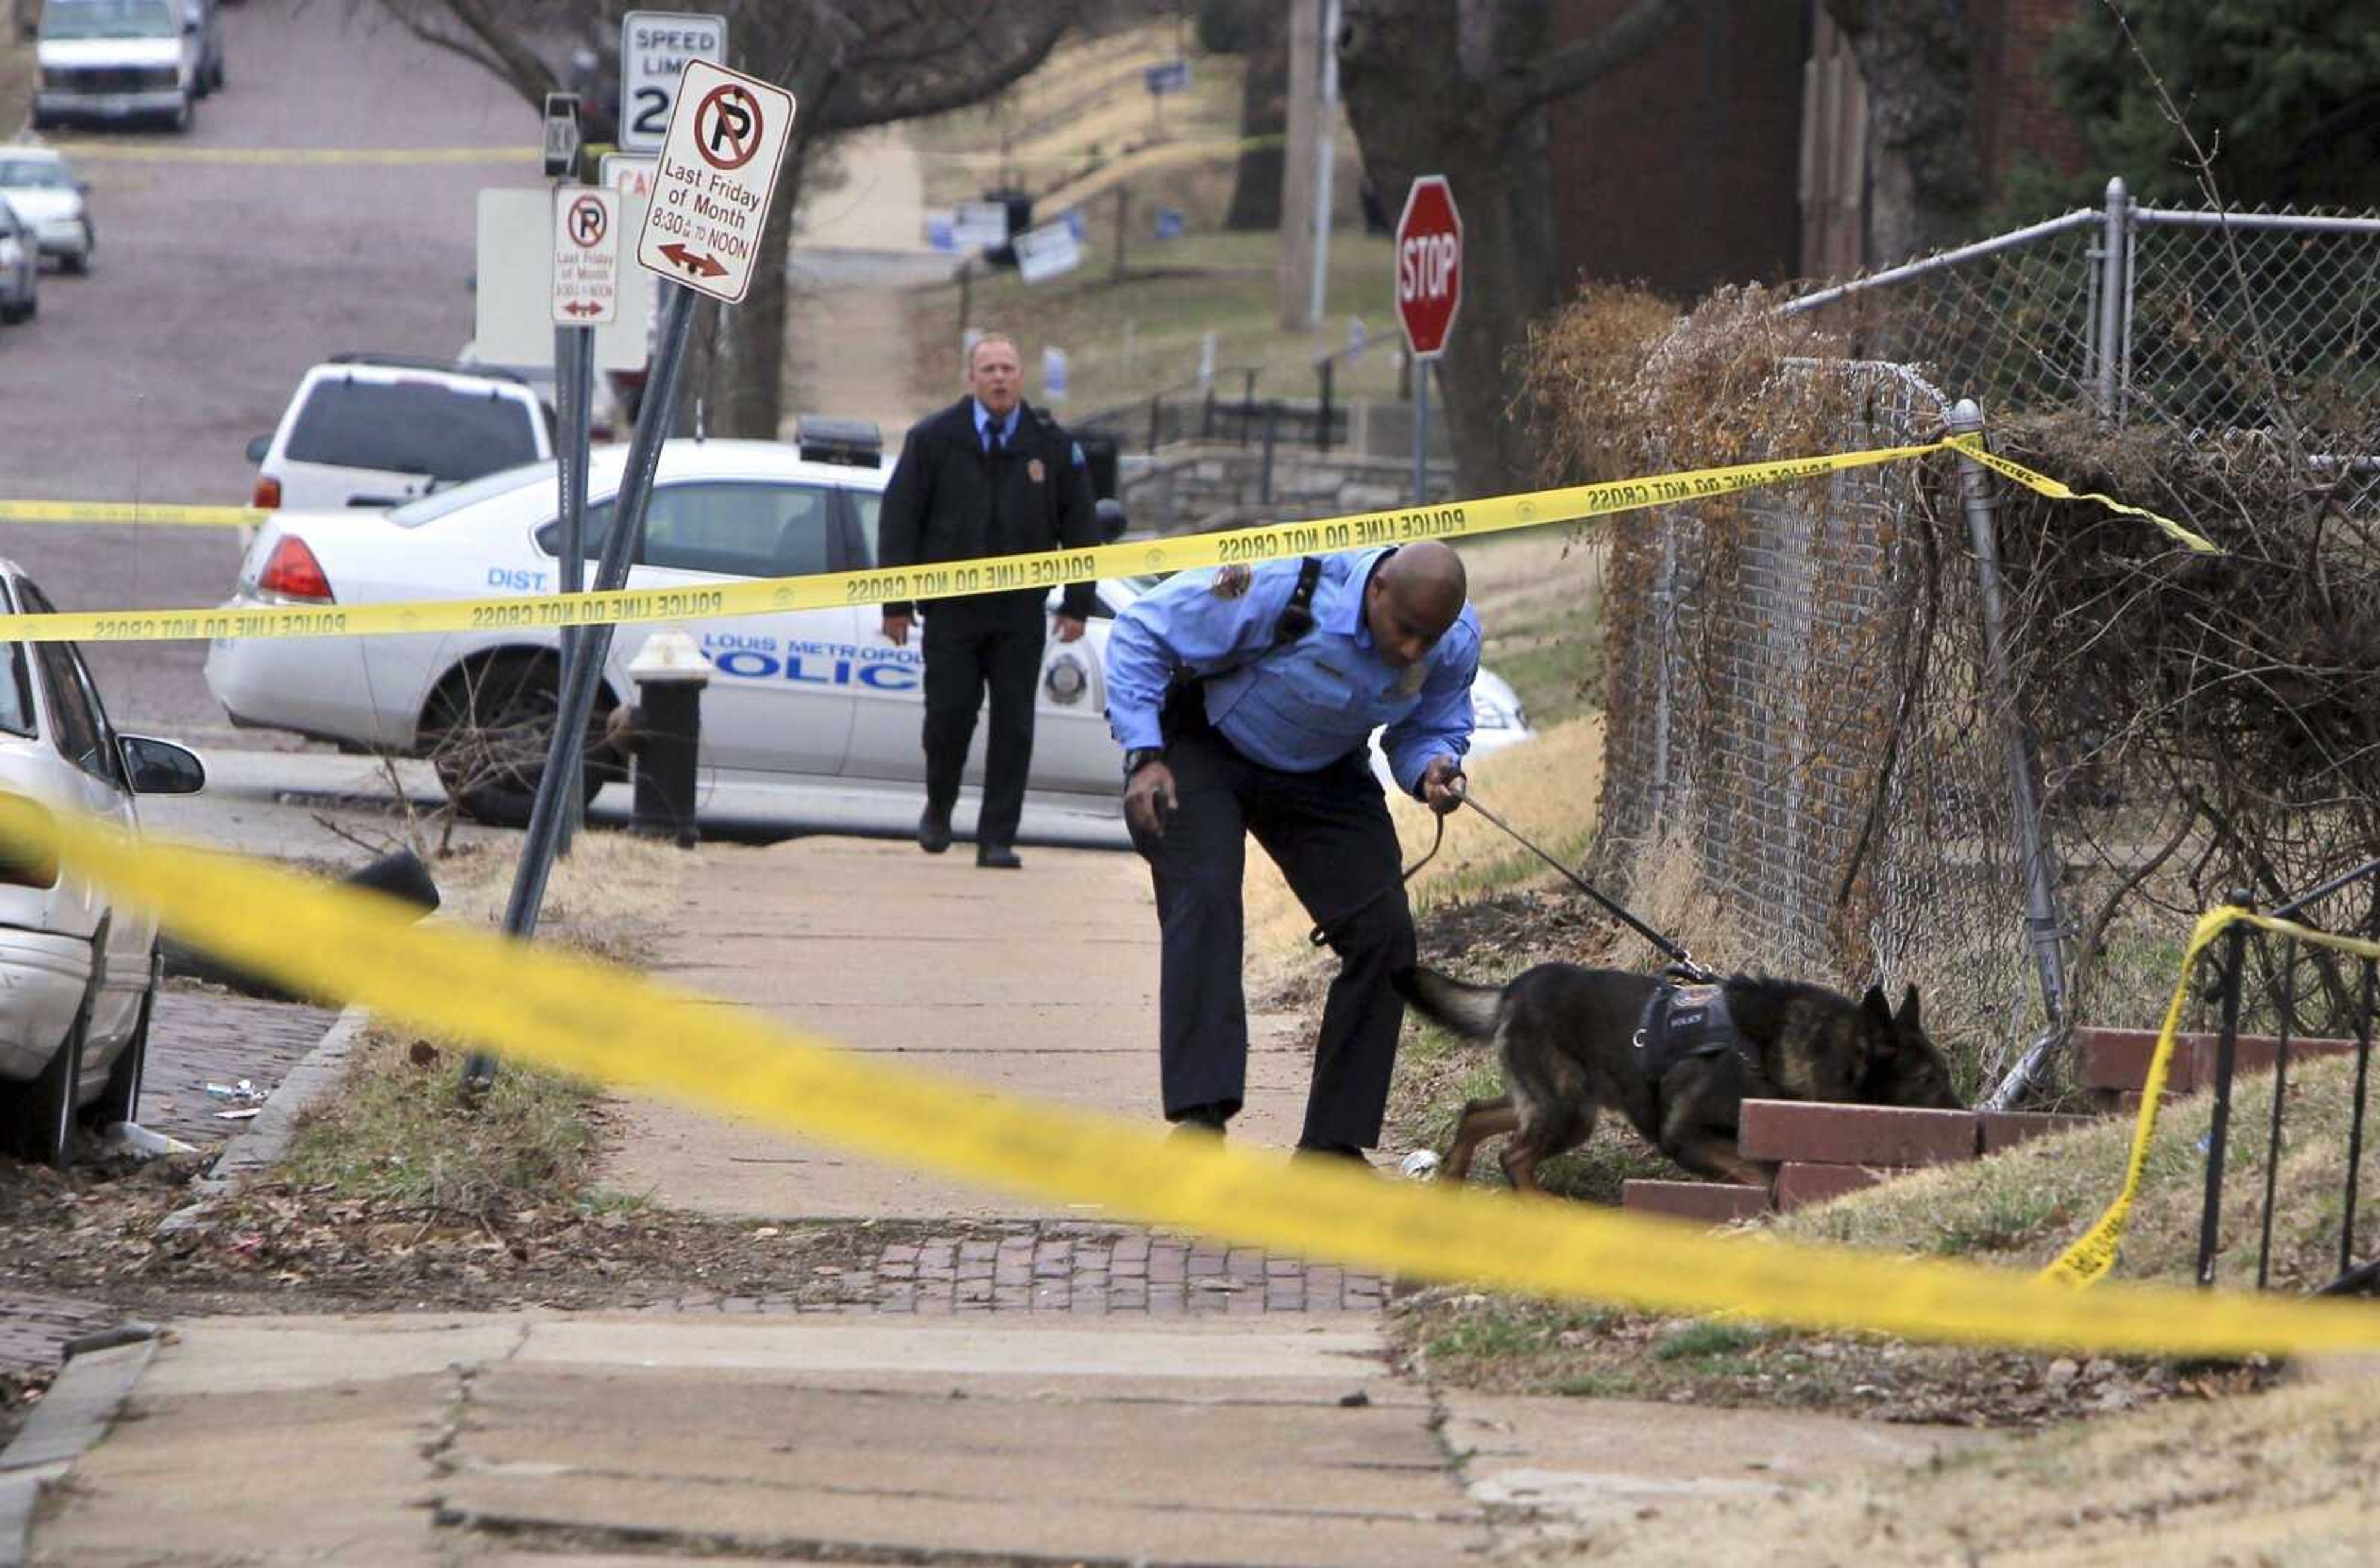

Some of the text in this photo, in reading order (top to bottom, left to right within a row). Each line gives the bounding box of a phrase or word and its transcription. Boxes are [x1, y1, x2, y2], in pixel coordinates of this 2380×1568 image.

[636, 29, 715, 50] SPEED
[643, 56, 687, 75] LIM
[633, 86, 669, 133] 2
[665, 157, 760, 211] Last Friday
[669, 189, 746, 229] of Month
[653, 207, 682, 234] 8:30
[708, 228, 749, 259] NOON
[1402, 233, 1455, 301] STOP
[488, 568, 548, 592] DIST.
[705, 633, 924, 664] LOUIS METROPOL
[700, 650, 919, 689] OLIC
